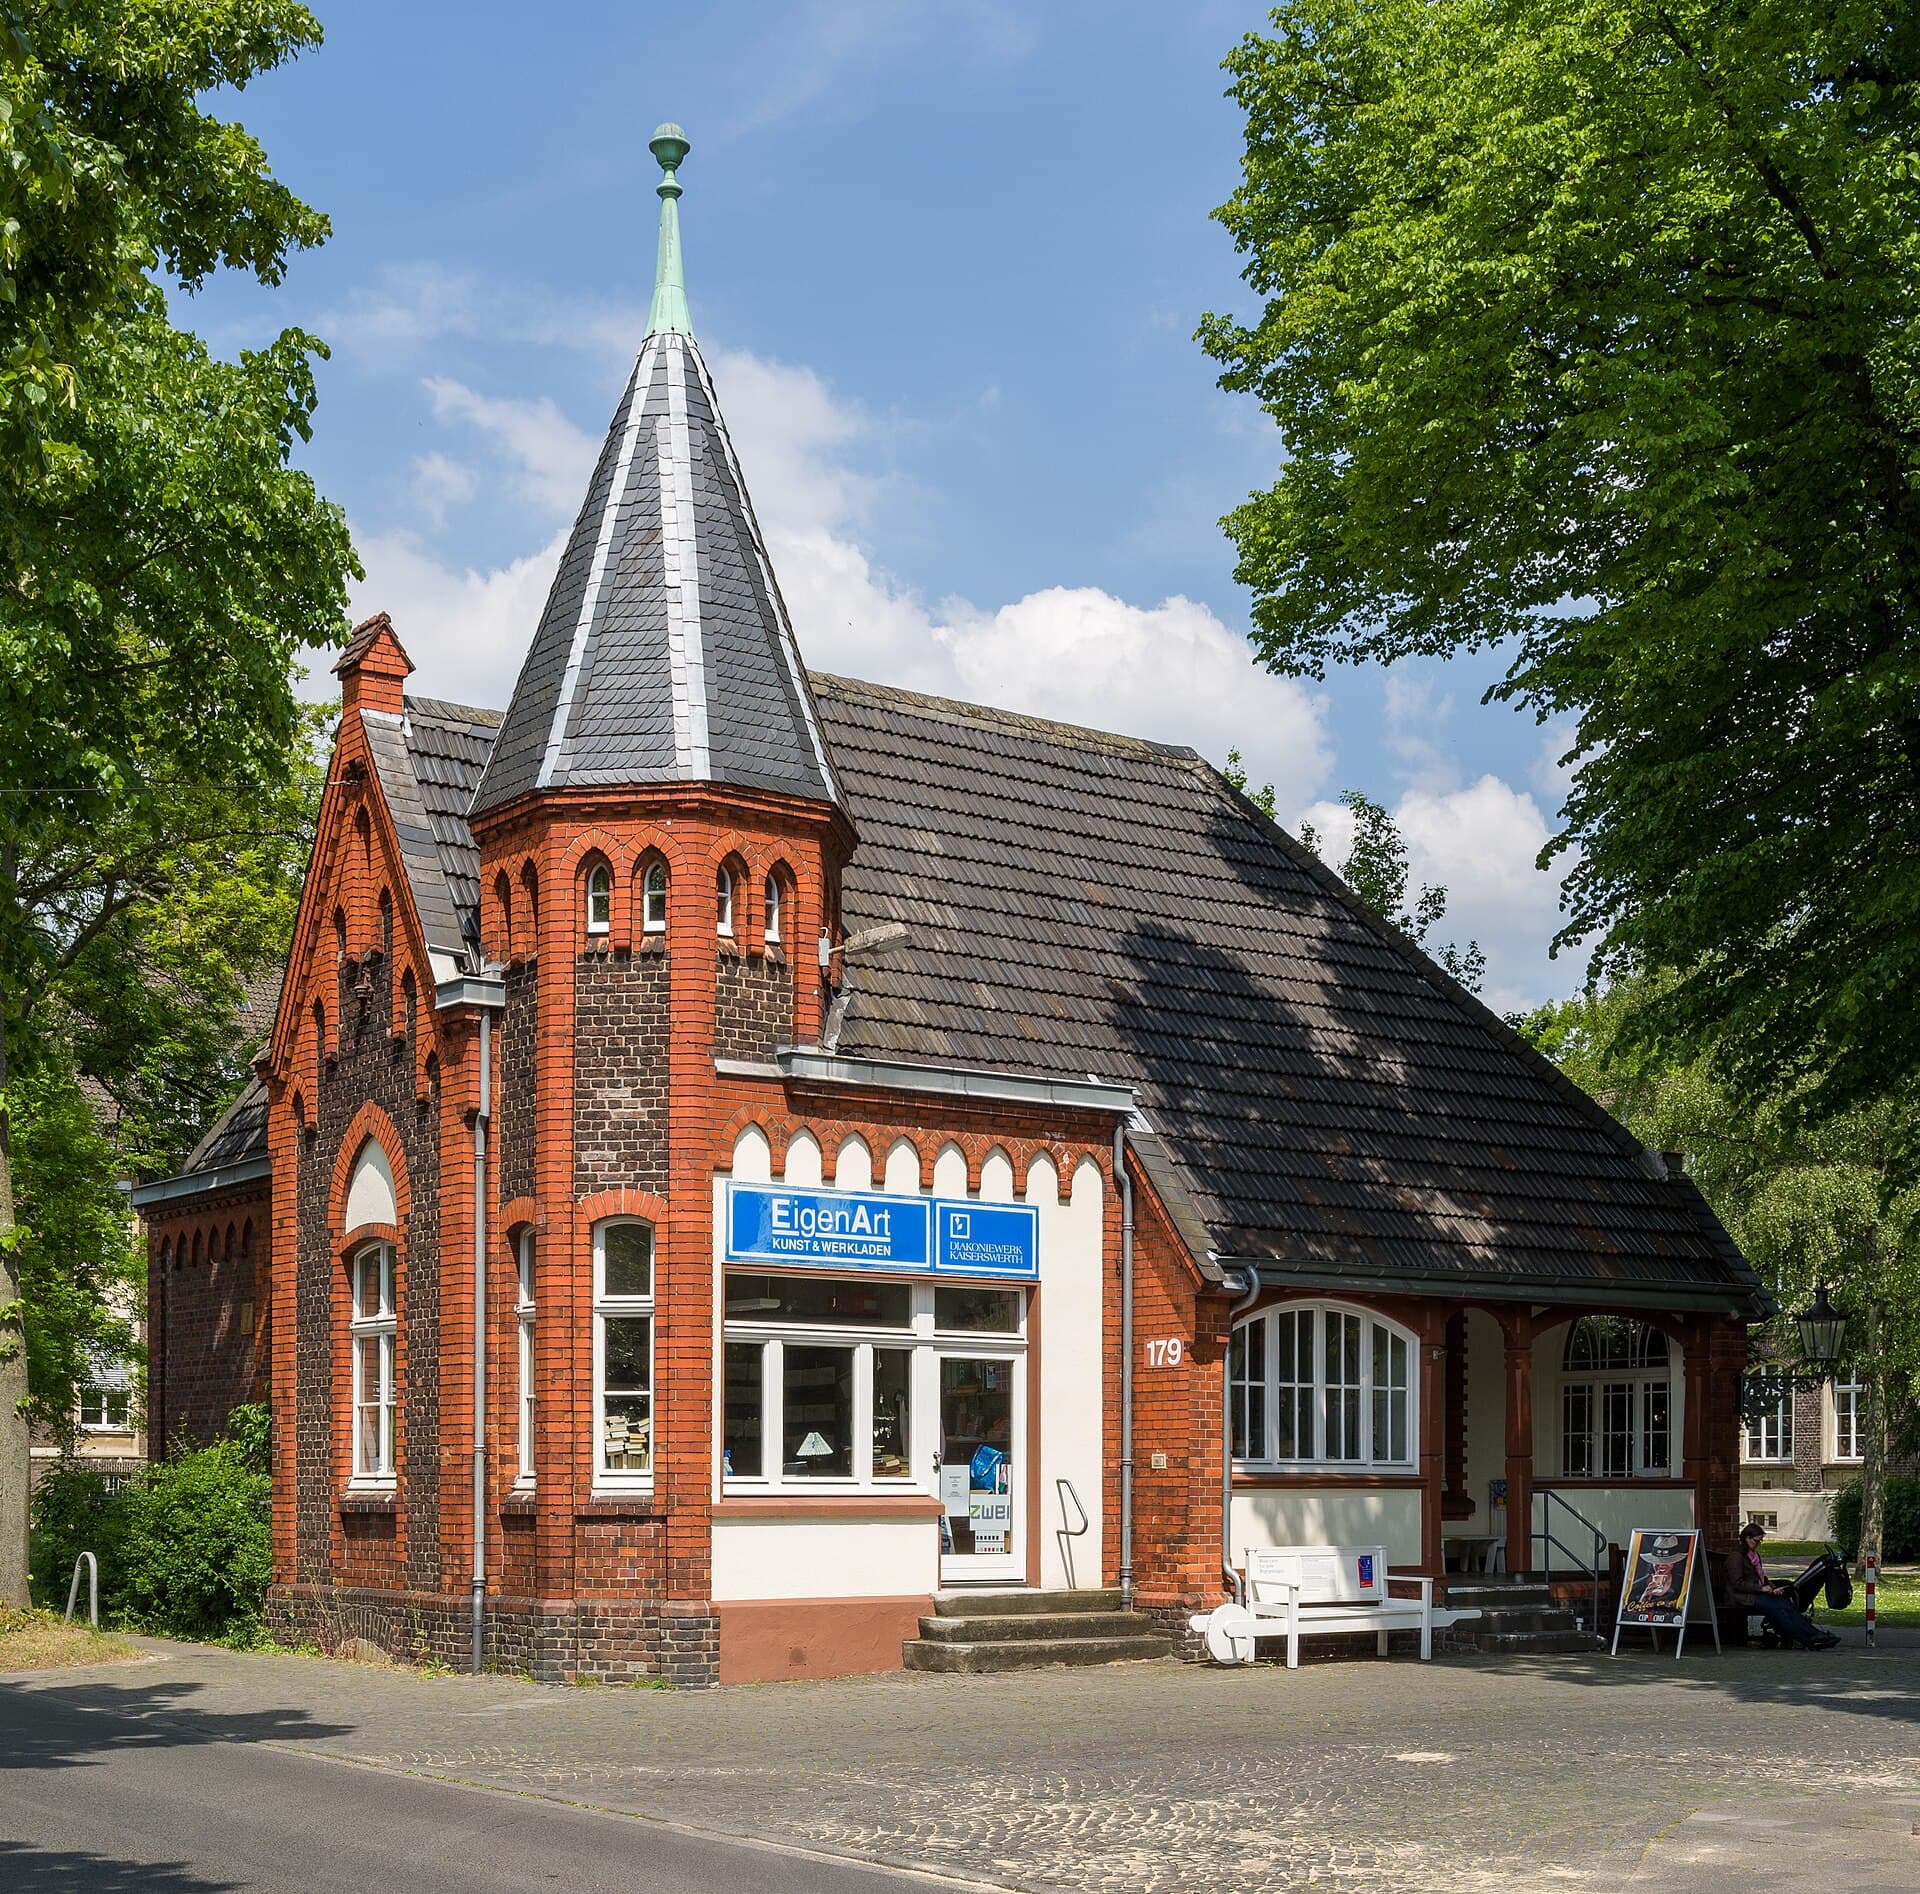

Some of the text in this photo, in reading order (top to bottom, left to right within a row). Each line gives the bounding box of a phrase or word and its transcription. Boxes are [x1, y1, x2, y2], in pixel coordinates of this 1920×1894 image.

[772, 1198, 891, 1238] EigenArt
[772, 1238, 891, 1256] KUNST & WERKLADEN
[950, 1241, 1023, 1255] DIAKONIEWERK
[950, 1250, 1023, 1264] KAISERSWERTH
[1146, 1338, 1181, 1366] 179
[1627, 1601, 1654, 1612] Coffee
